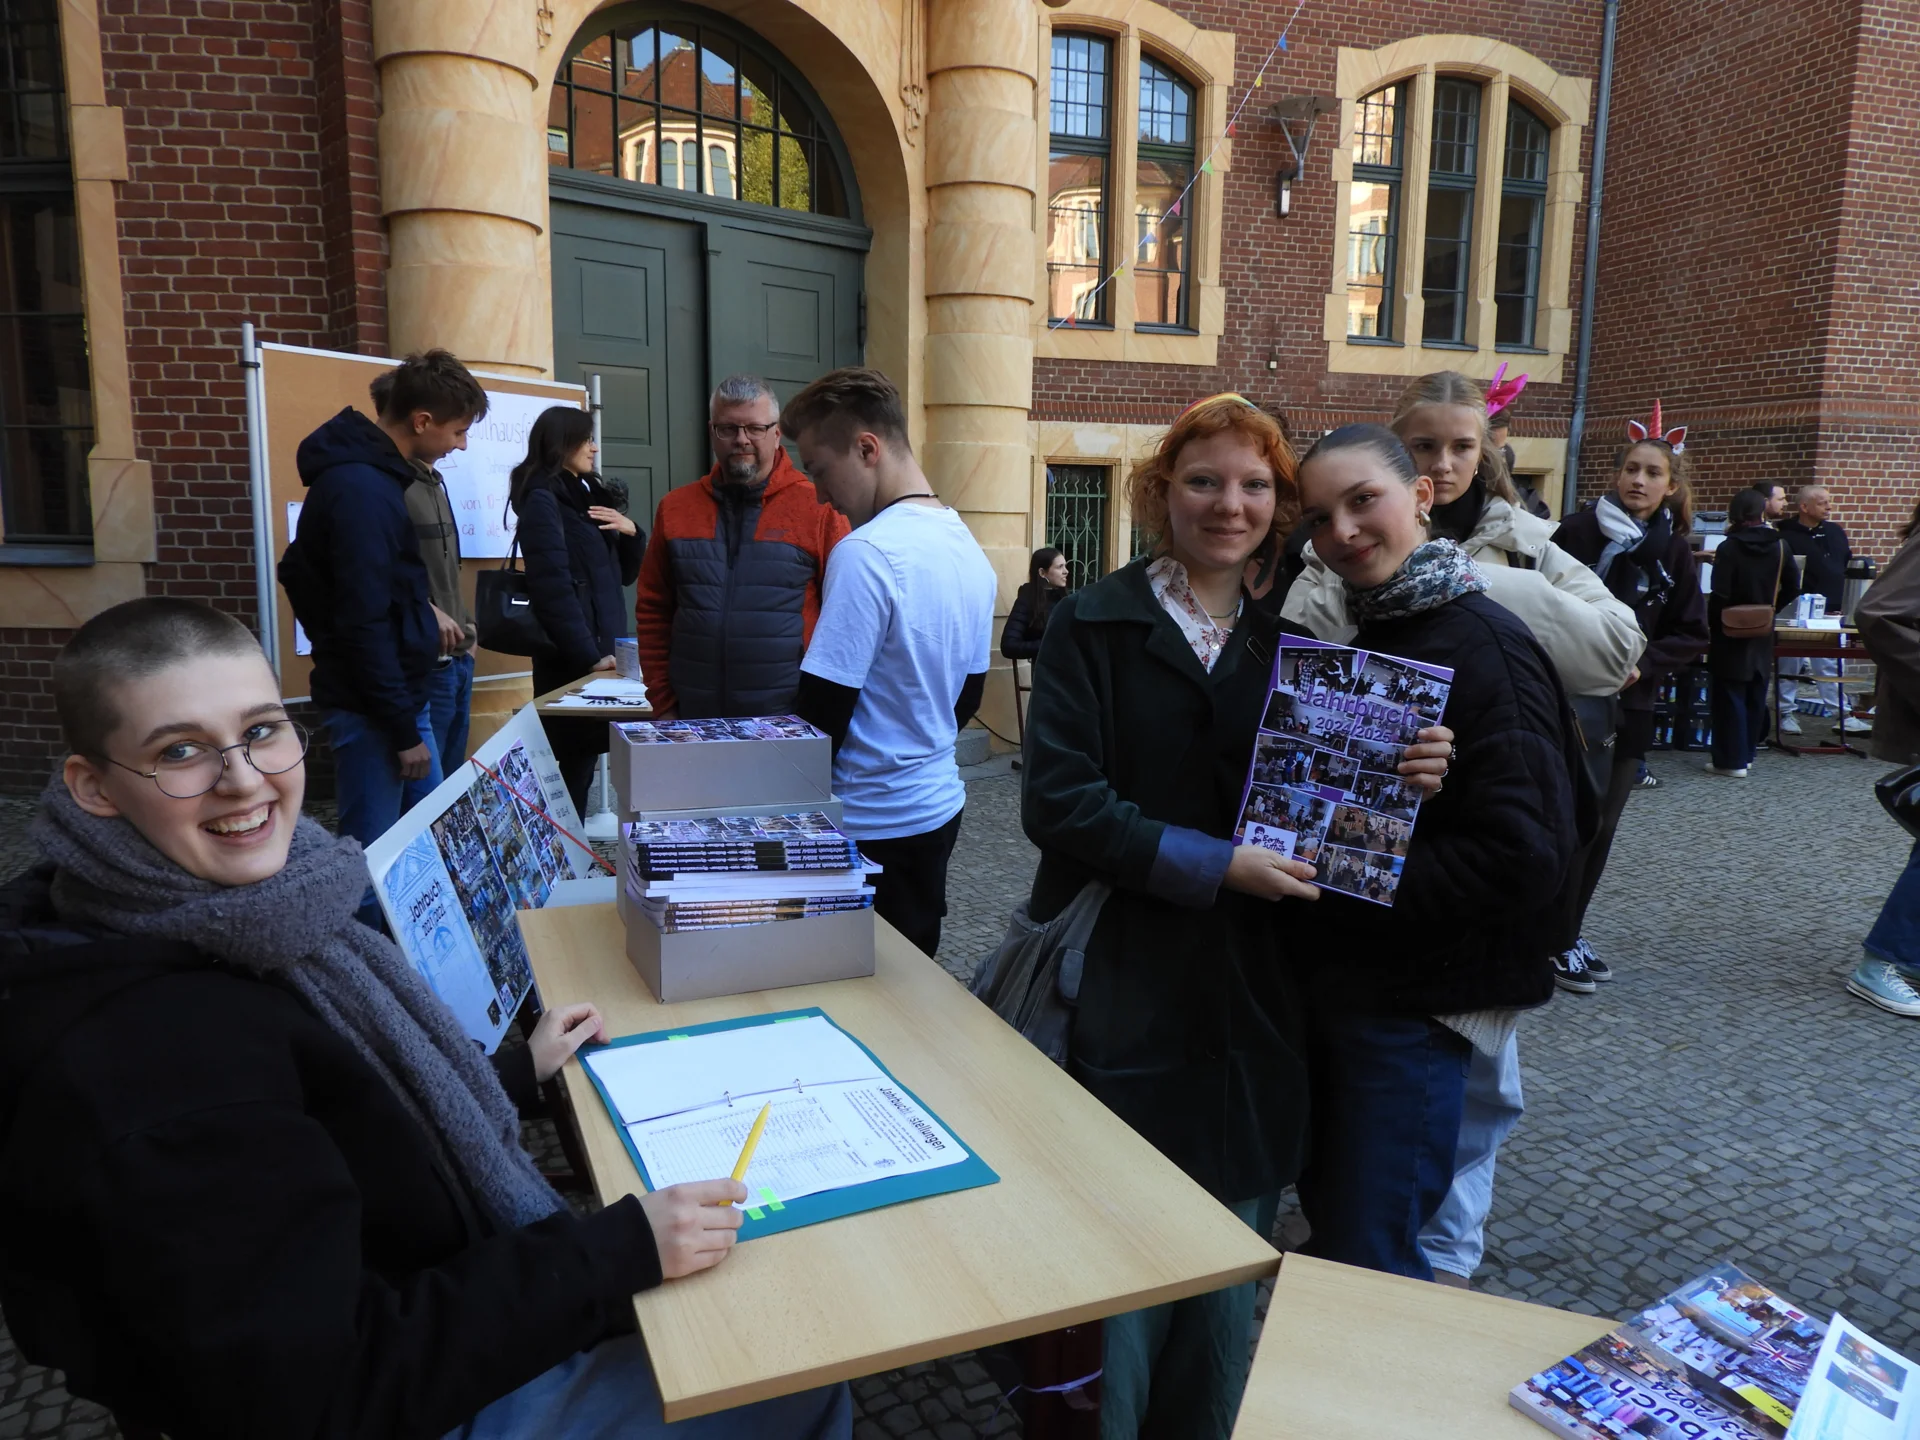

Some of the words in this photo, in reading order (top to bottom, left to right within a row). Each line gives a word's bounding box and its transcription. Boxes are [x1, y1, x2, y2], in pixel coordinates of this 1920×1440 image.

[1298, 685, 1417, 727] Jahrbuch
[1314, 716, 1393, 744] 2024/2025
[409, 878, 443, 923] Jahrbuch
[1609, 1378, 1722, 1440] buch
[1651, 1380, 1760, 1440] 23/2024
